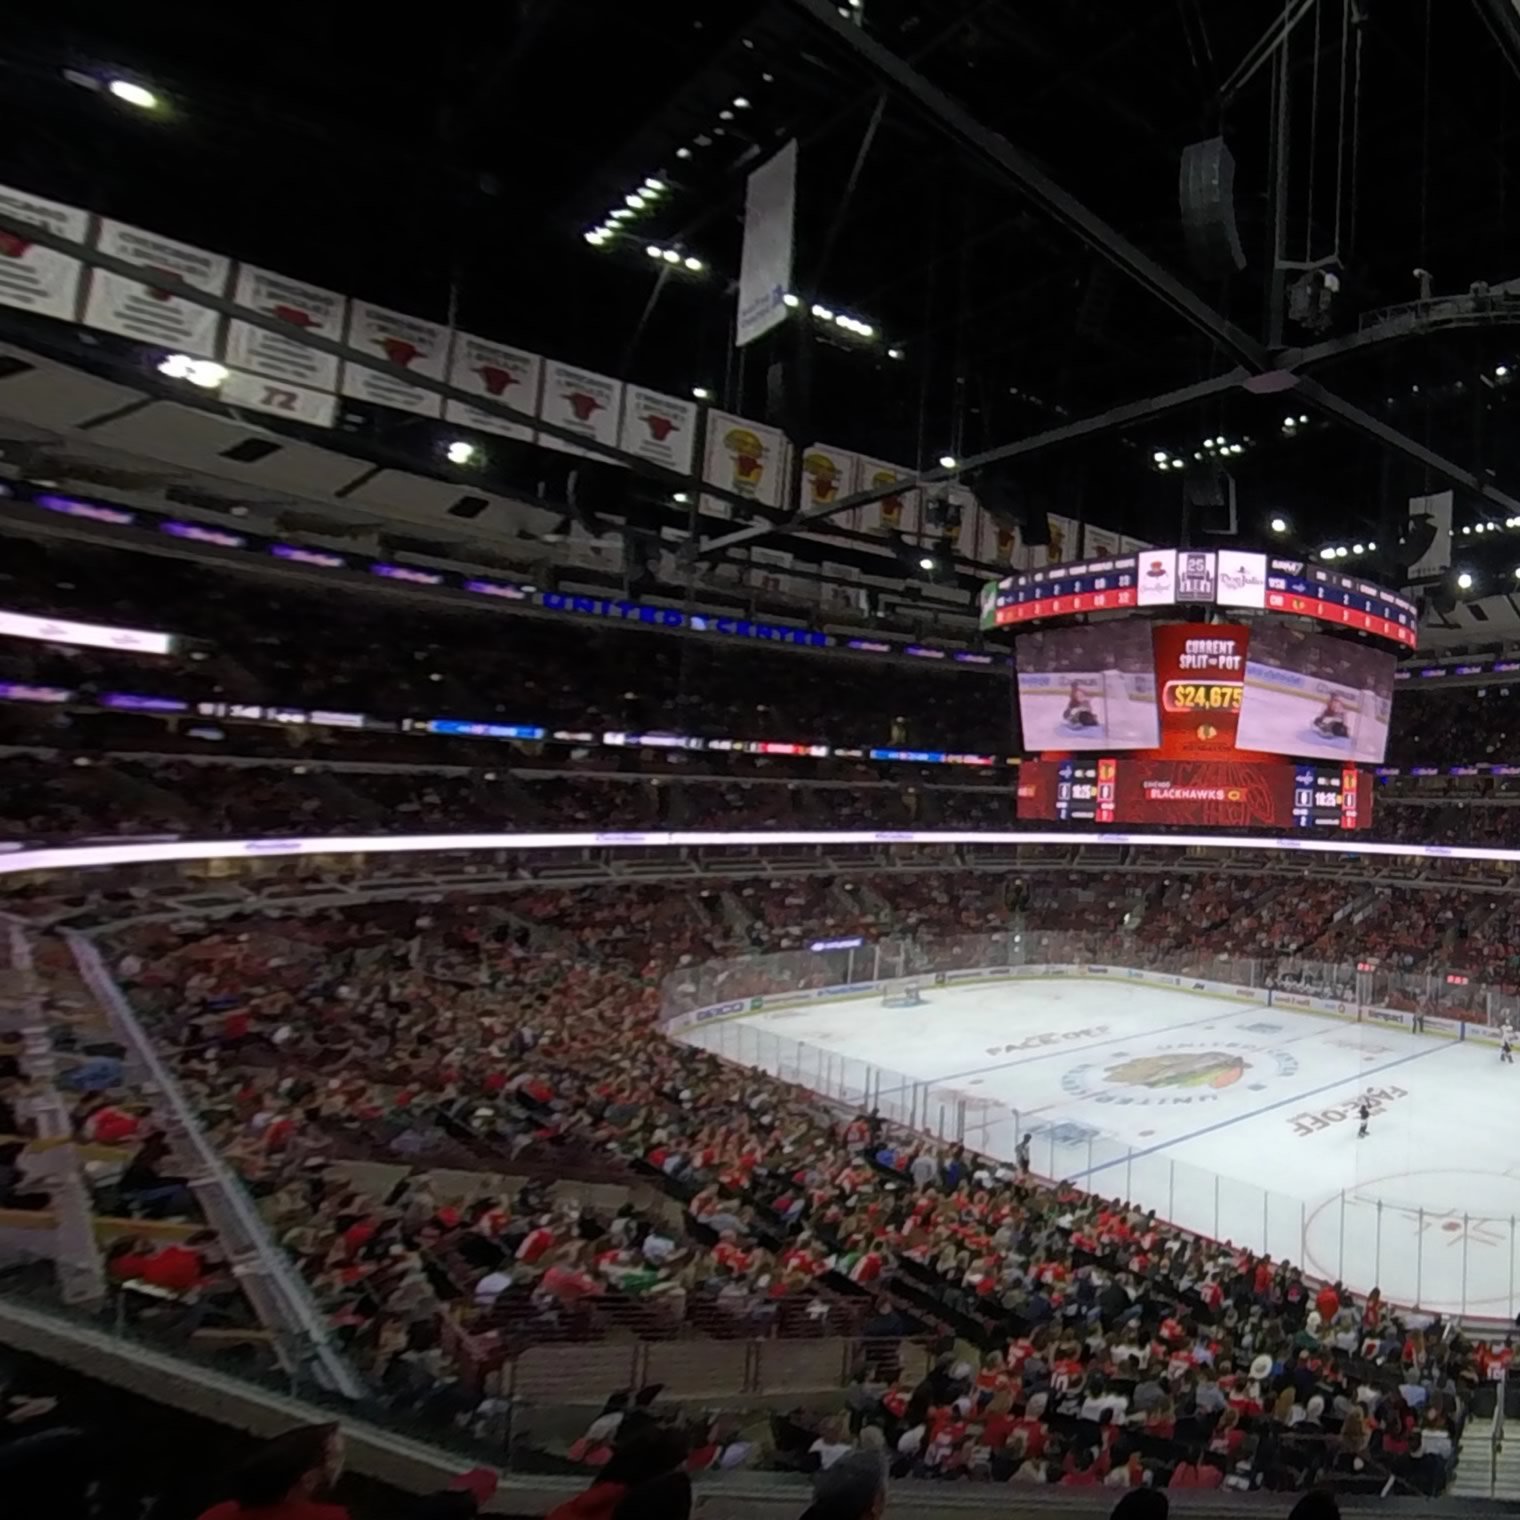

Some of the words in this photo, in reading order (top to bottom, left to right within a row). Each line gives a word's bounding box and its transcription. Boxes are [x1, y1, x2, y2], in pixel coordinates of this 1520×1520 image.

[1185, 639, 1235, 655] CURRENT
[1174, 684, 1243, 710] $24,675
[1150, 788, 1225, 801] BLACKHAWKS
